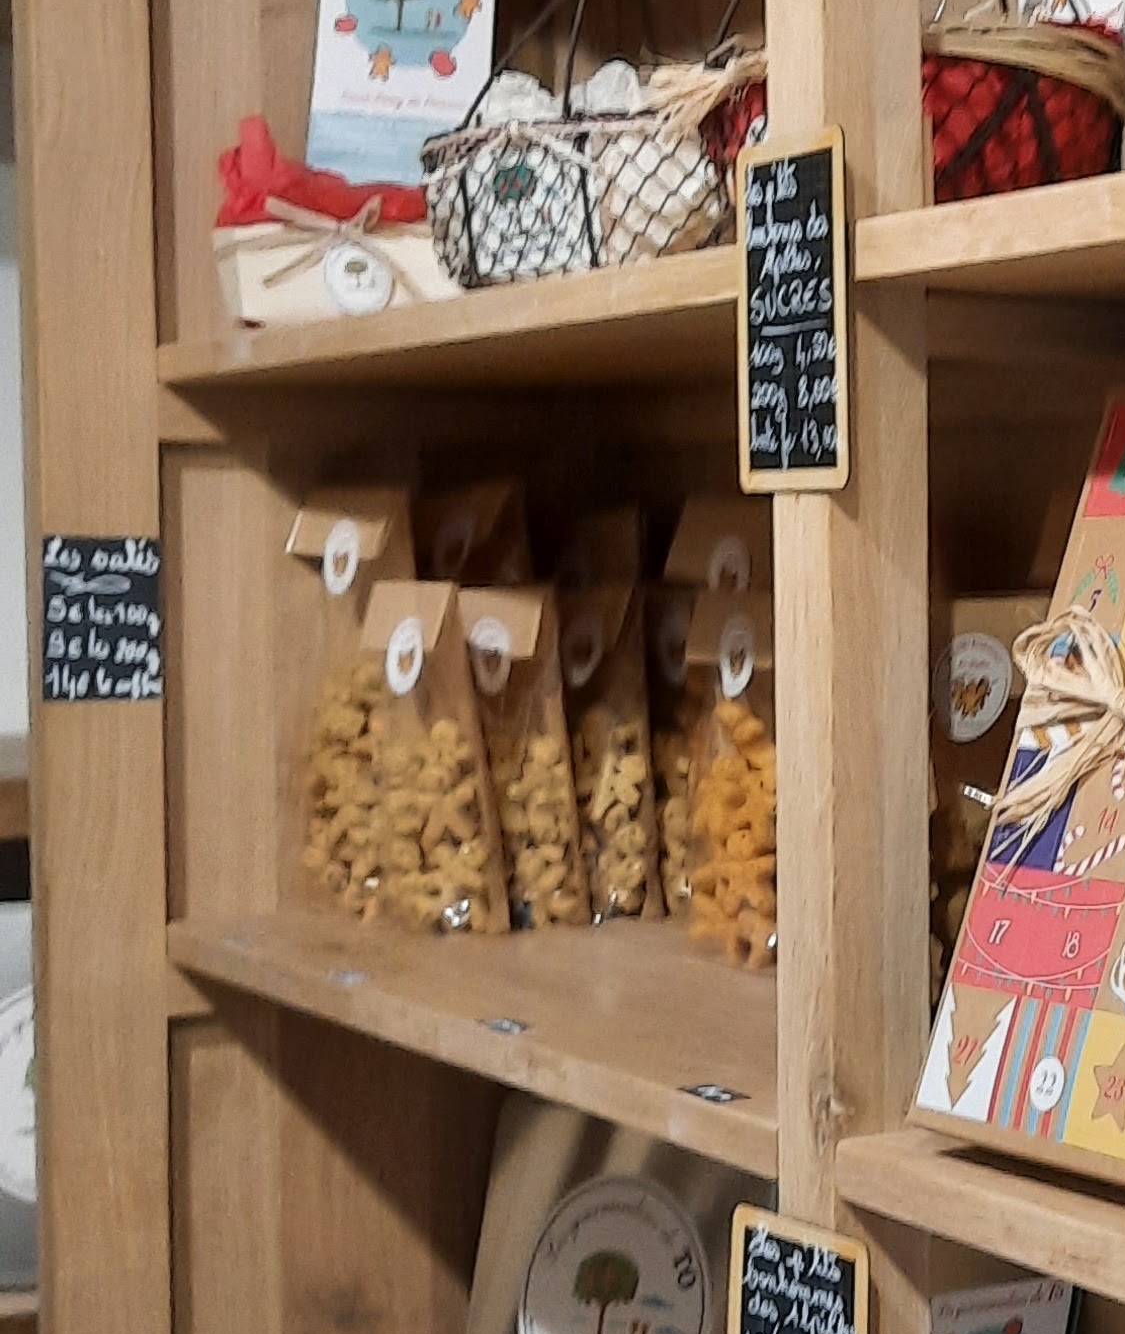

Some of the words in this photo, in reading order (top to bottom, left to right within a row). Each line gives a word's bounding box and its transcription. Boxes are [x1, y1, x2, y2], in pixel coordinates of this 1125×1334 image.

[1097, 805, 1119, 835] 14
[987, 918, 1011, 945] 17
[1061, 930, 1080, 959] 18
[953, 1034, 979, 1066] 21
